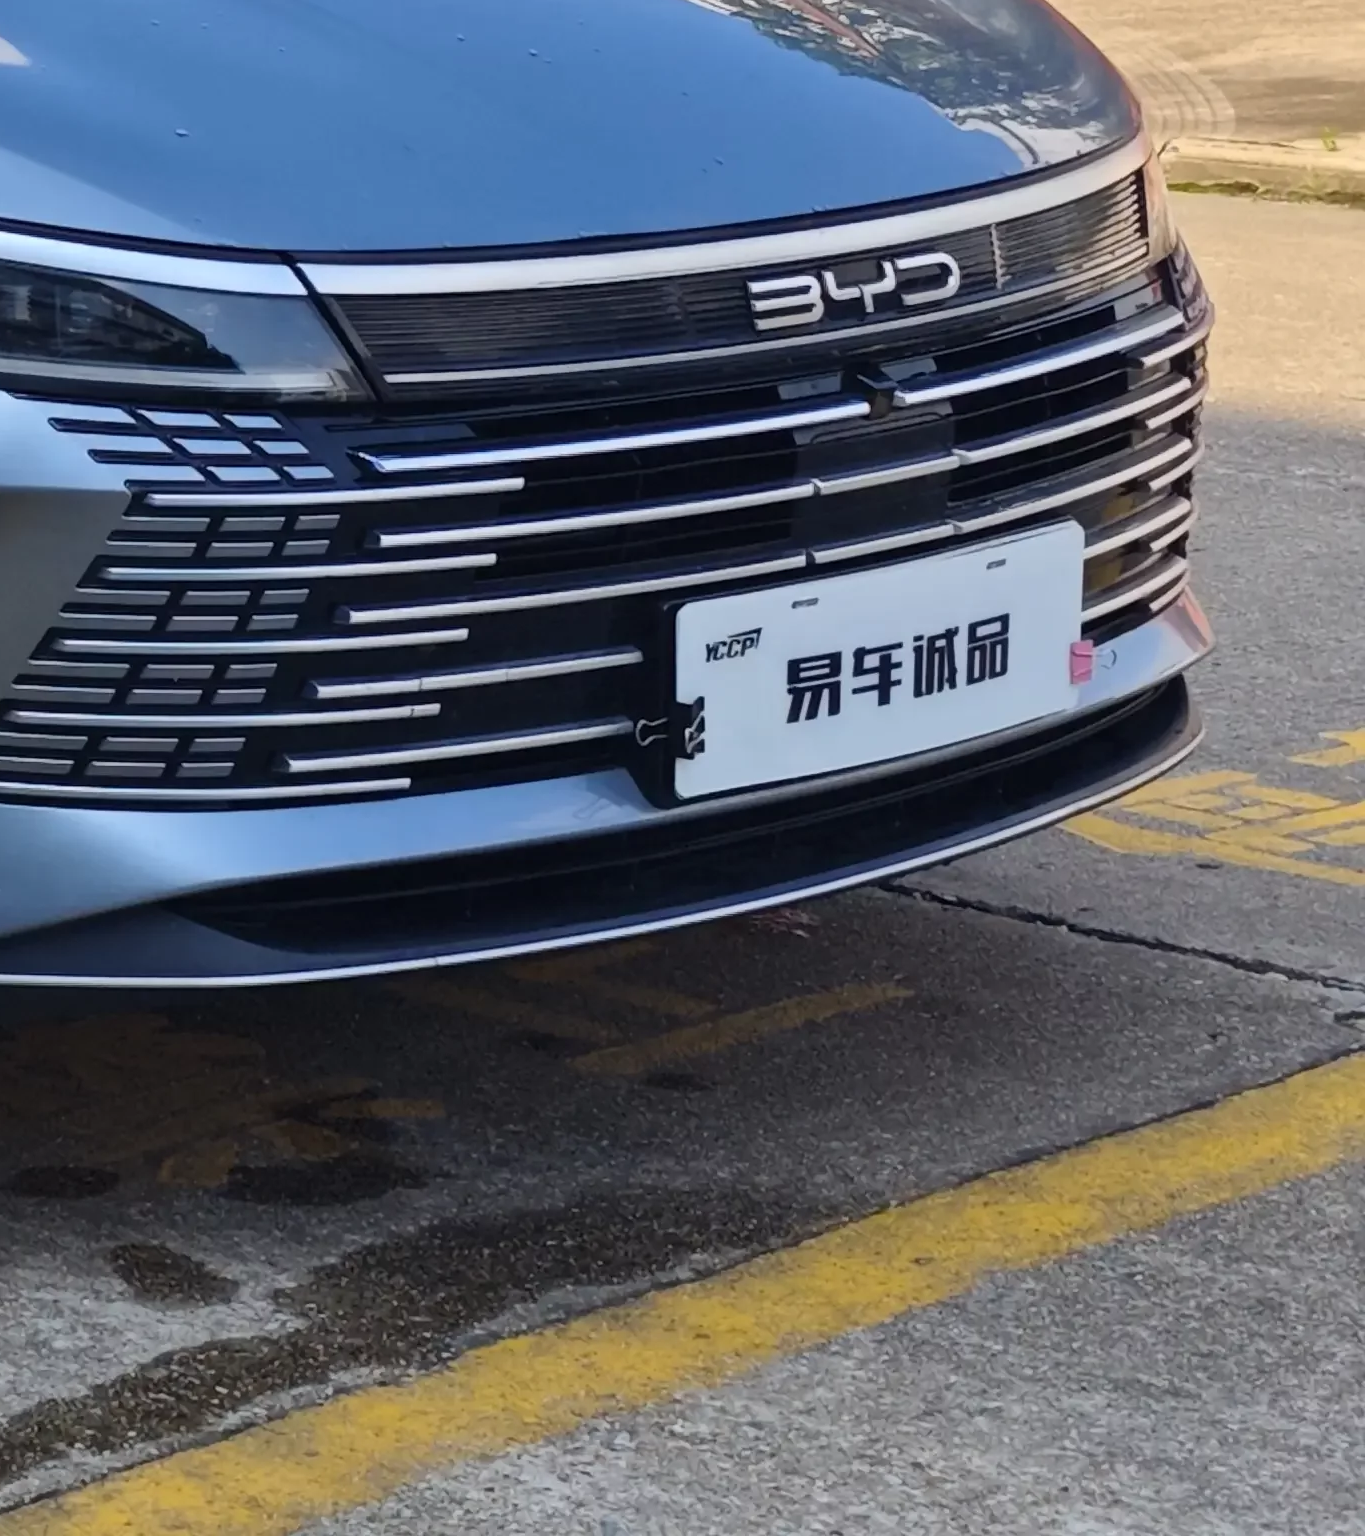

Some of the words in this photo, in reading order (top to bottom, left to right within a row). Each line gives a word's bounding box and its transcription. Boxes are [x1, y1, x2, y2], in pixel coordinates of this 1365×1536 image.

[746, 252, 961, 331] BYD
[705, 629, 761, 663] YCCP
[786, 613, 1010, 724] 易车诚品
